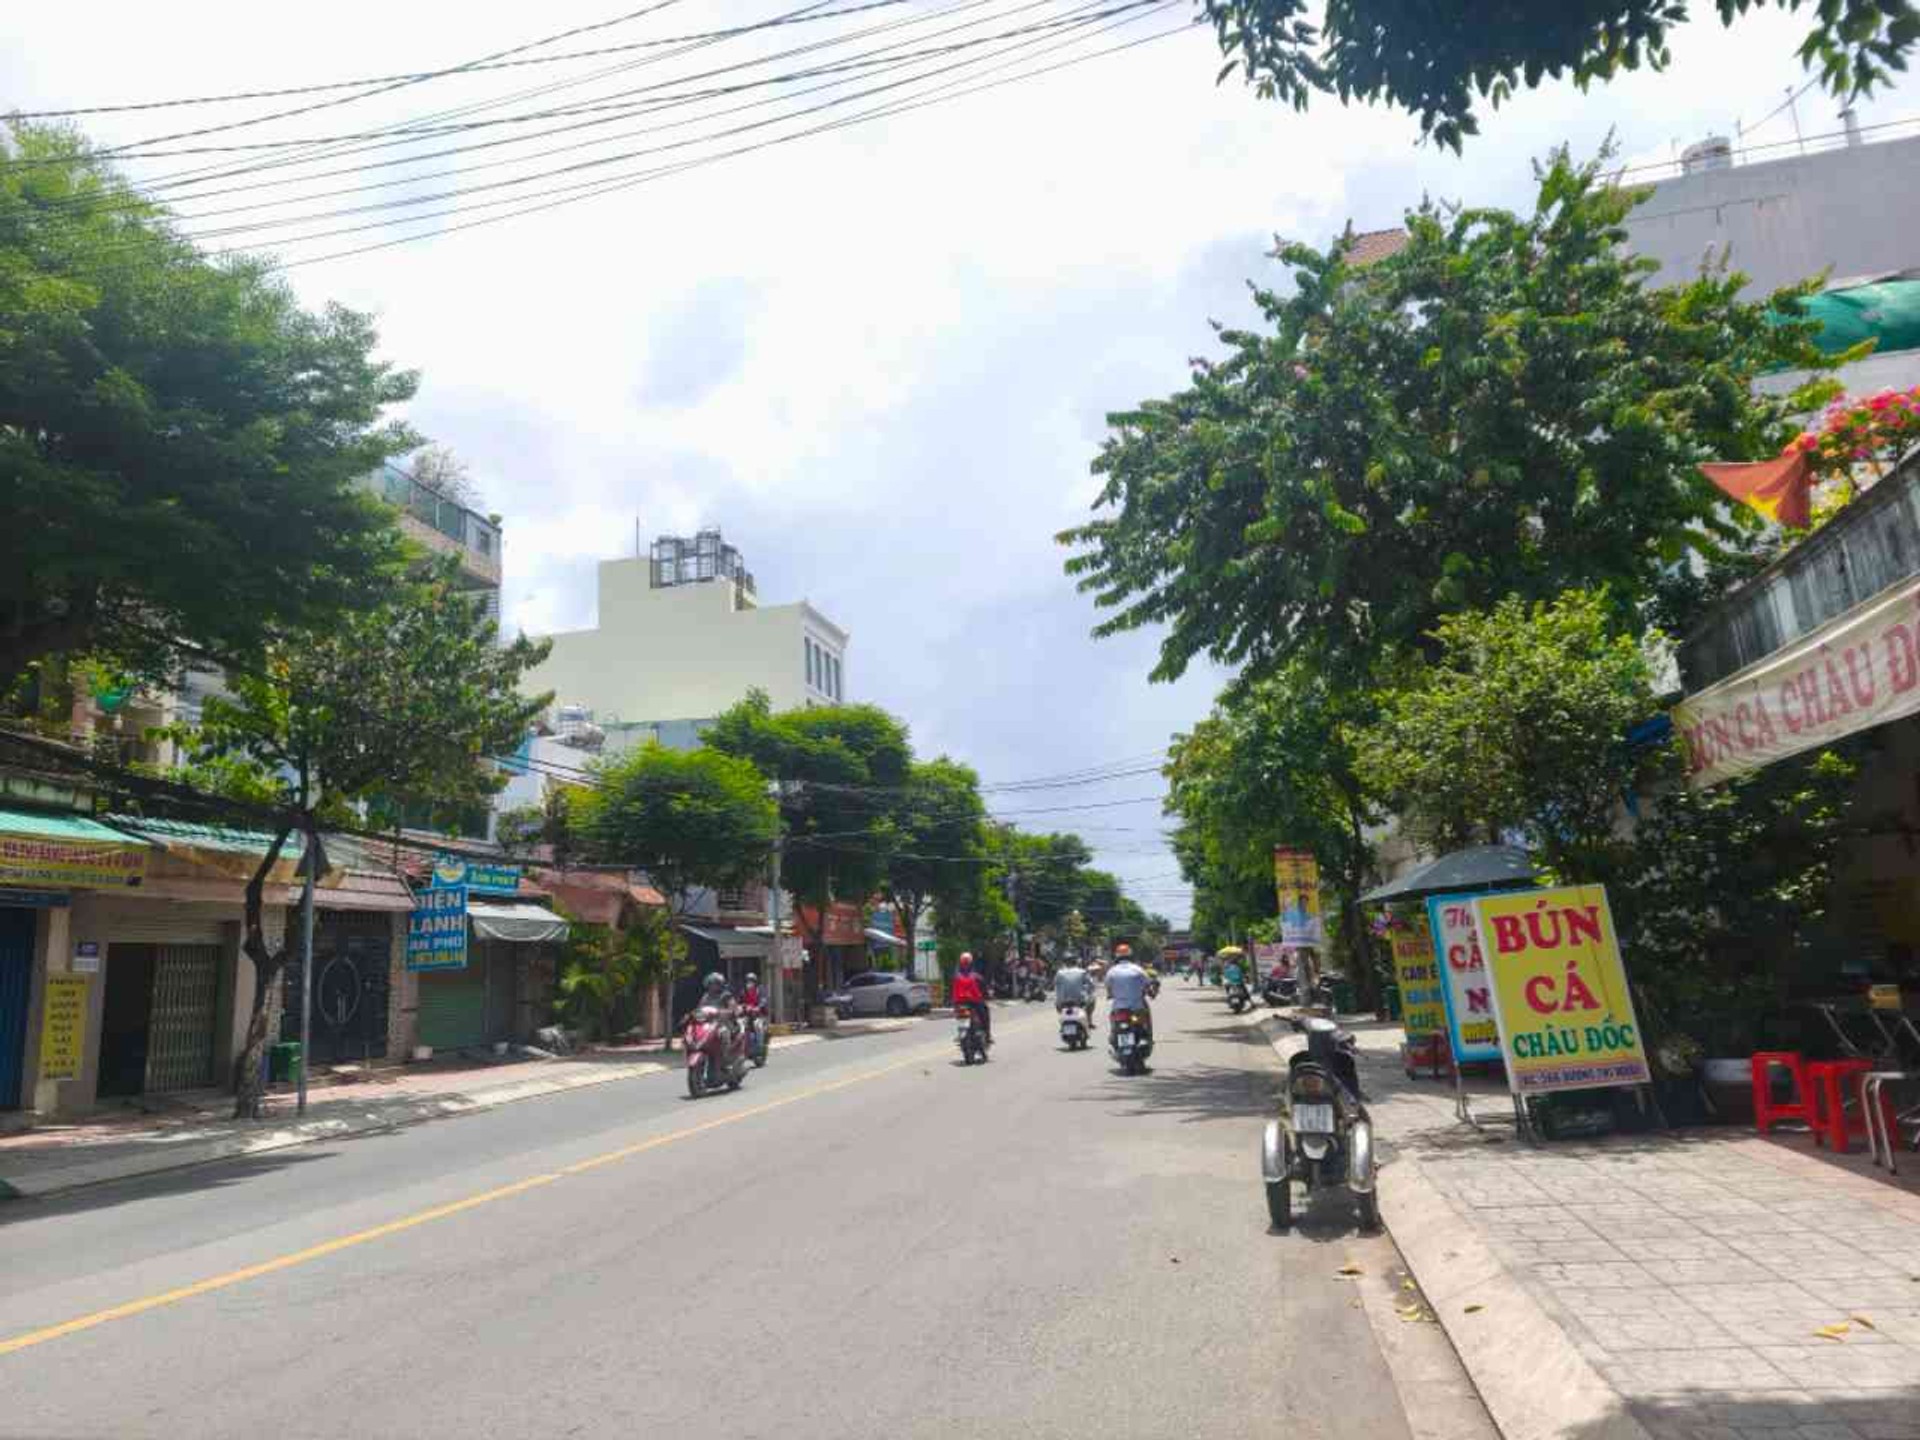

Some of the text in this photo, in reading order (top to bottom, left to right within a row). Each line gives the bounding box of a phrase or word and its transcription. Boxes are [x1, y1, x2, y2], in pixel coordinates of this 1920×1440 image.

[1881, 590, 1920, 695] Đ
[1490, 900, 1603, 954] BÚN
[1523, 960, 1601, 1015] CÁ
[1512, 1023, 1577, 1059] CHÂU
[1586, 1012, 1635, 1052] ĐỐC
